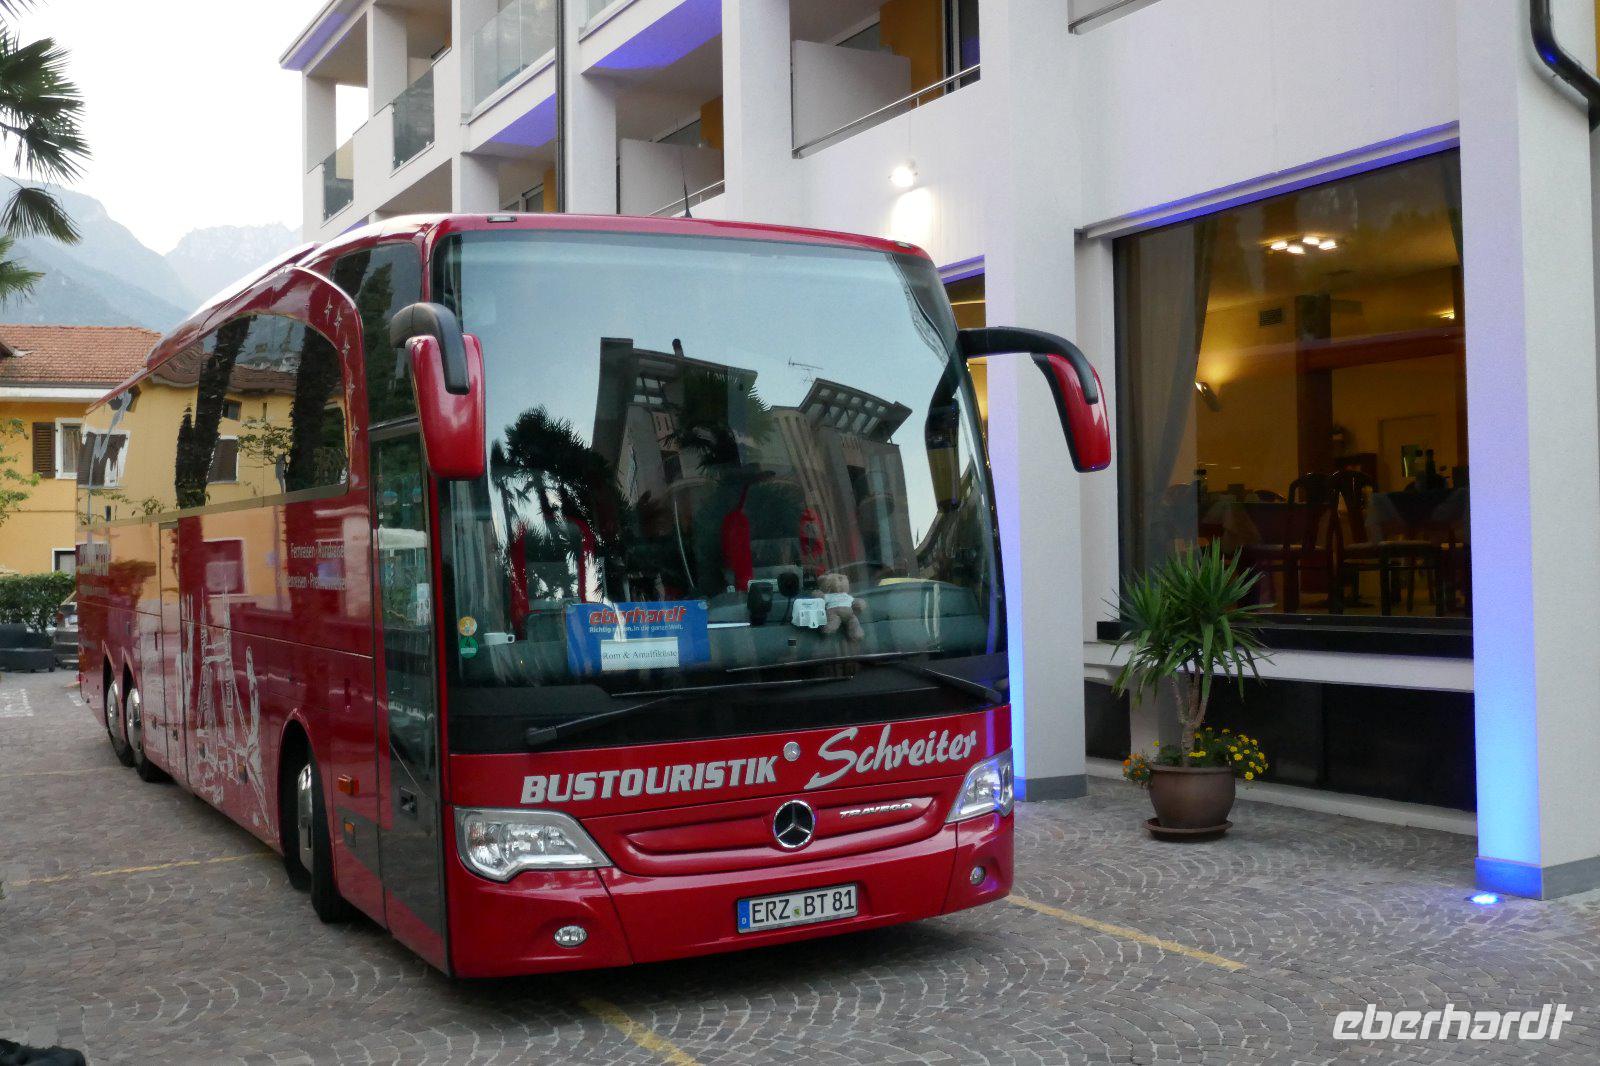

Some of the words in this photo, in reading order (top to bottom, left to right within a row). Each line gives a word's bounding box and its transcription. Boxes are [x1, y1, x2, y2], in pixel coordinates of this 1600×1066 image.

[602, 652, 621, 660] Rom
[623, 651, 631, 659] &
[804, 724, 977, 790] Schreiter
[520, 756, 778, 804] BUSTOURISTIK
[840, 802, 913, 819] TRAVEGO
[752, 899, 790, 923] ERZ
[804, 893, 828, 916] BT
[832, 889, 855, 911] 81
